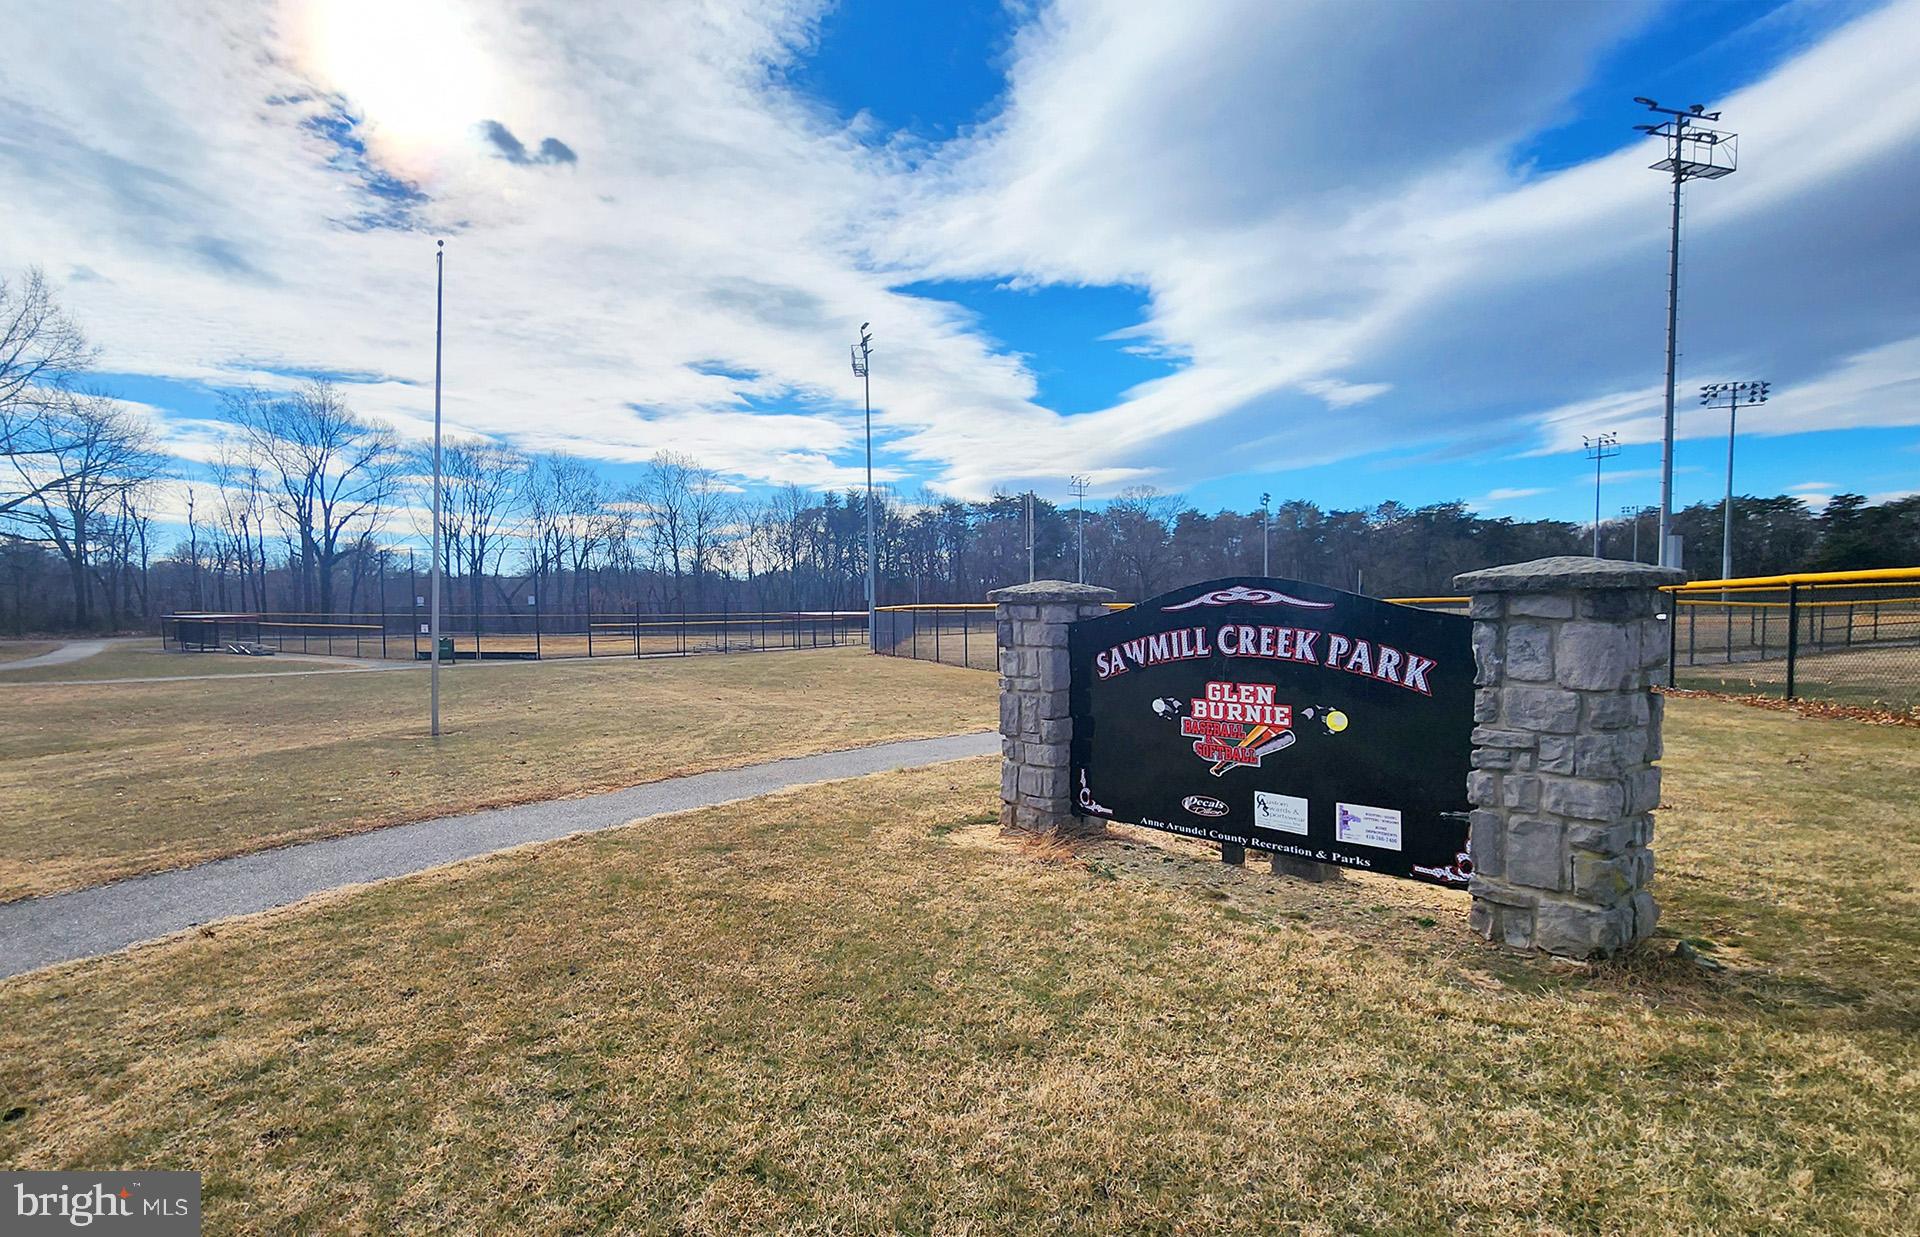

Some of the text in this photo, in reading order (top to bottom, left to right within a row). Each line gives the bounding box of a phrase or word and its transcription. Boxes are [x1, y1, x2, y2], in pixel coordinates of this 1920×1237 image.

[1096, 624, 1438, 696] SAWMILL CREEK PARK
[1206, 682, 1276, 705] GLEN
[1192, 700, 1291, 726] BURNIE
[1184, 719, 1247, 739] BASEBALL
[1196, 743, 1258, 763] SOFTBALL
[1189, 796, 1224, 809] Decals
[1140, 817, 1371, 867] Anne Arundel County Recreation & Parks
